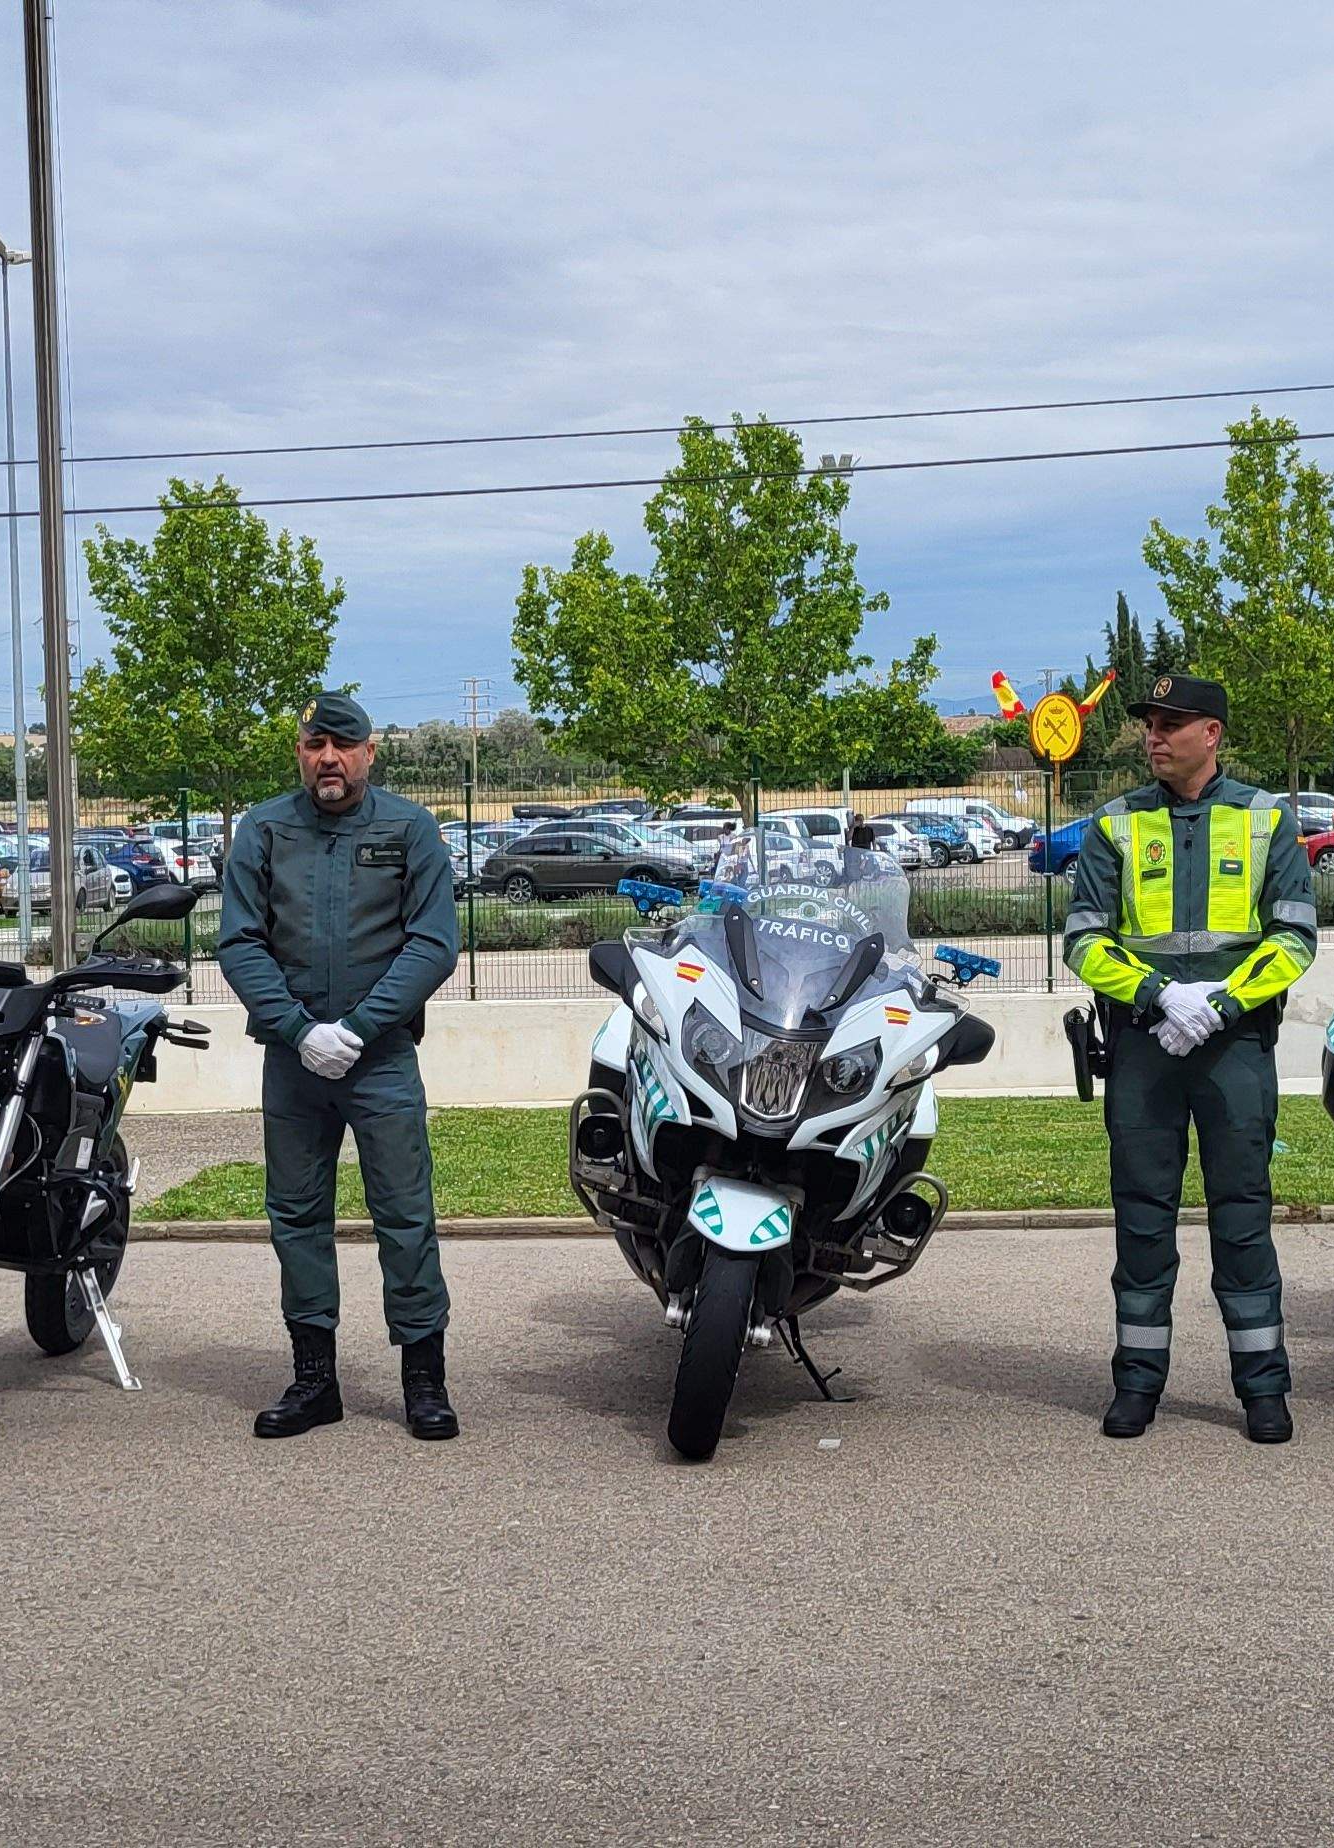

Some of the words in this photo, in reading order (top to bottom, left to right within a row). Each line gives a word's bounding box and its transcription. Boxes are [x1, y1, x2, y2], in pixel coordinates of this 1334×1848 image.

[747, 884, 829, 903] GUARDIA
[834, 896, 871, 932] CIVIL
[757, 919, 849, 948] TRÁFICO
